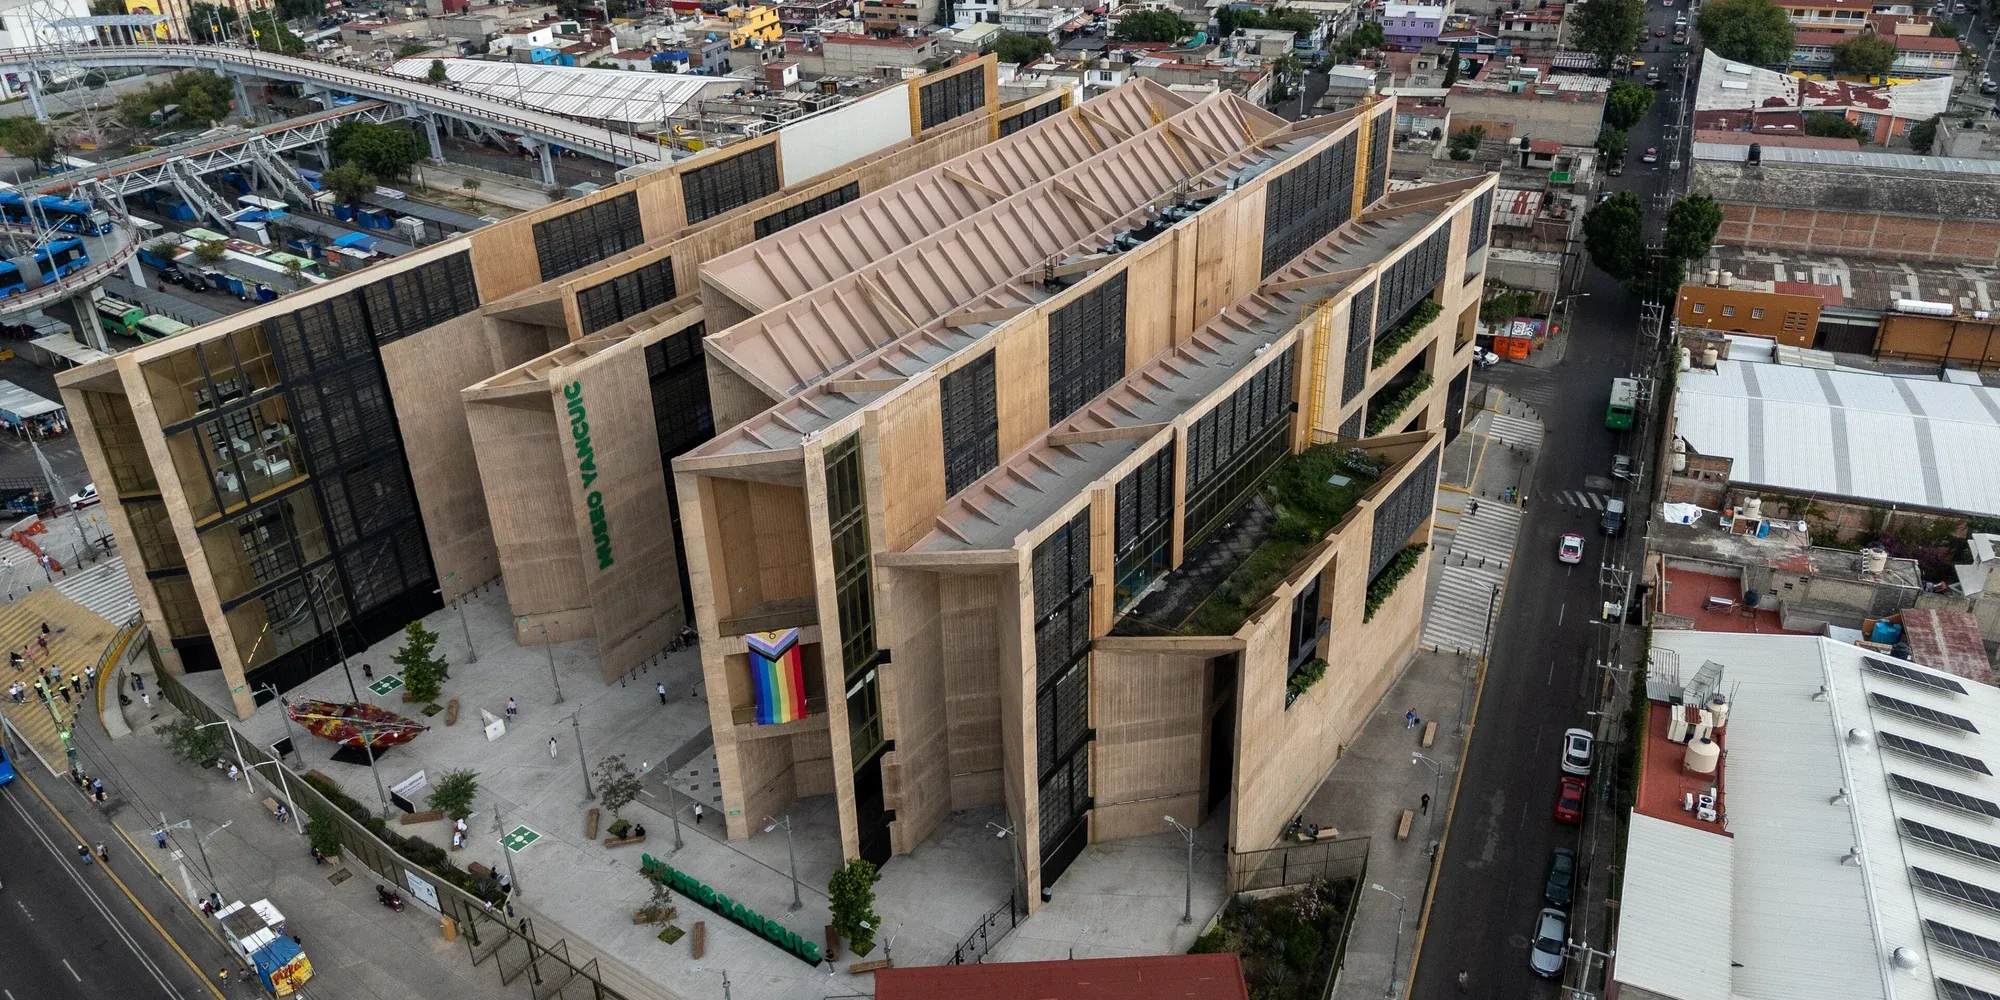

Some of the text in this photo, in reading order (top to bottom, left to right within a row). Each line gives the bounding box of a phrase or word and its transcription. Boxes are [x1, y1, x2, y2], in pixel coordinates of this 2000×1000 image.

[564, 381, 614, 570] MUSEO YANCUIC
[718, 893, 822, 962] YANCUIC
